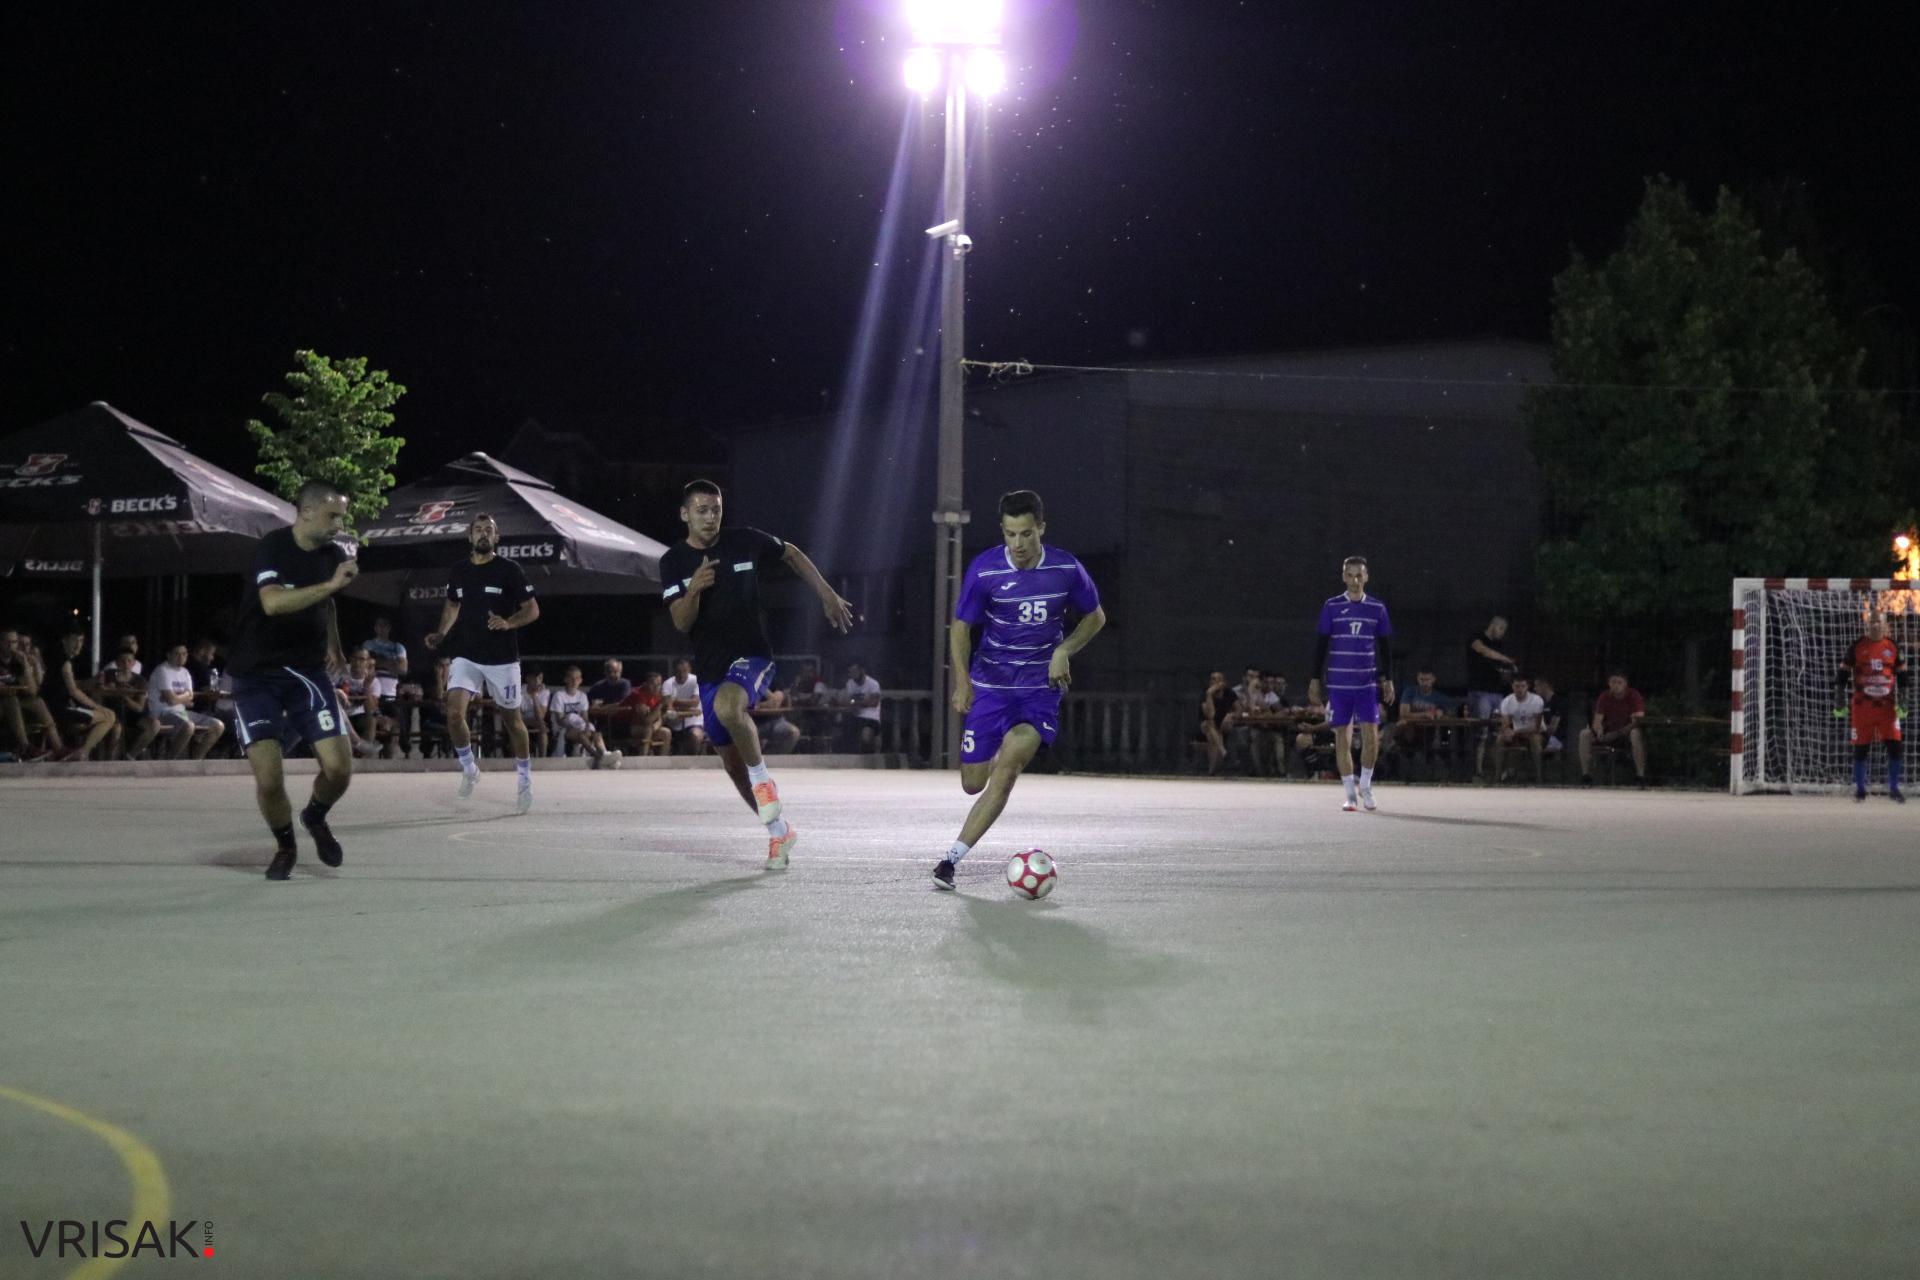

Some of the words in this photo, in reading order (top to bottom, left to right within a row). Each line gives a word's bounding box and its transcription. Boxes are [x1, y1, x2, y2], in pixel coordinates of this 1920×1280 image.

[110, 493, 177, 513] BECK'S
[361, 522, 470, 538] BECK'S
[497, 542, 554, 558] BECK'S
[1018, 600, 1048, 623] 35
[1349, 622, 1362, 635] 17
[503, 684, 517, 700] 11
[317, 709, 336, 732] 6
[961, 729, 975, 753] 5
